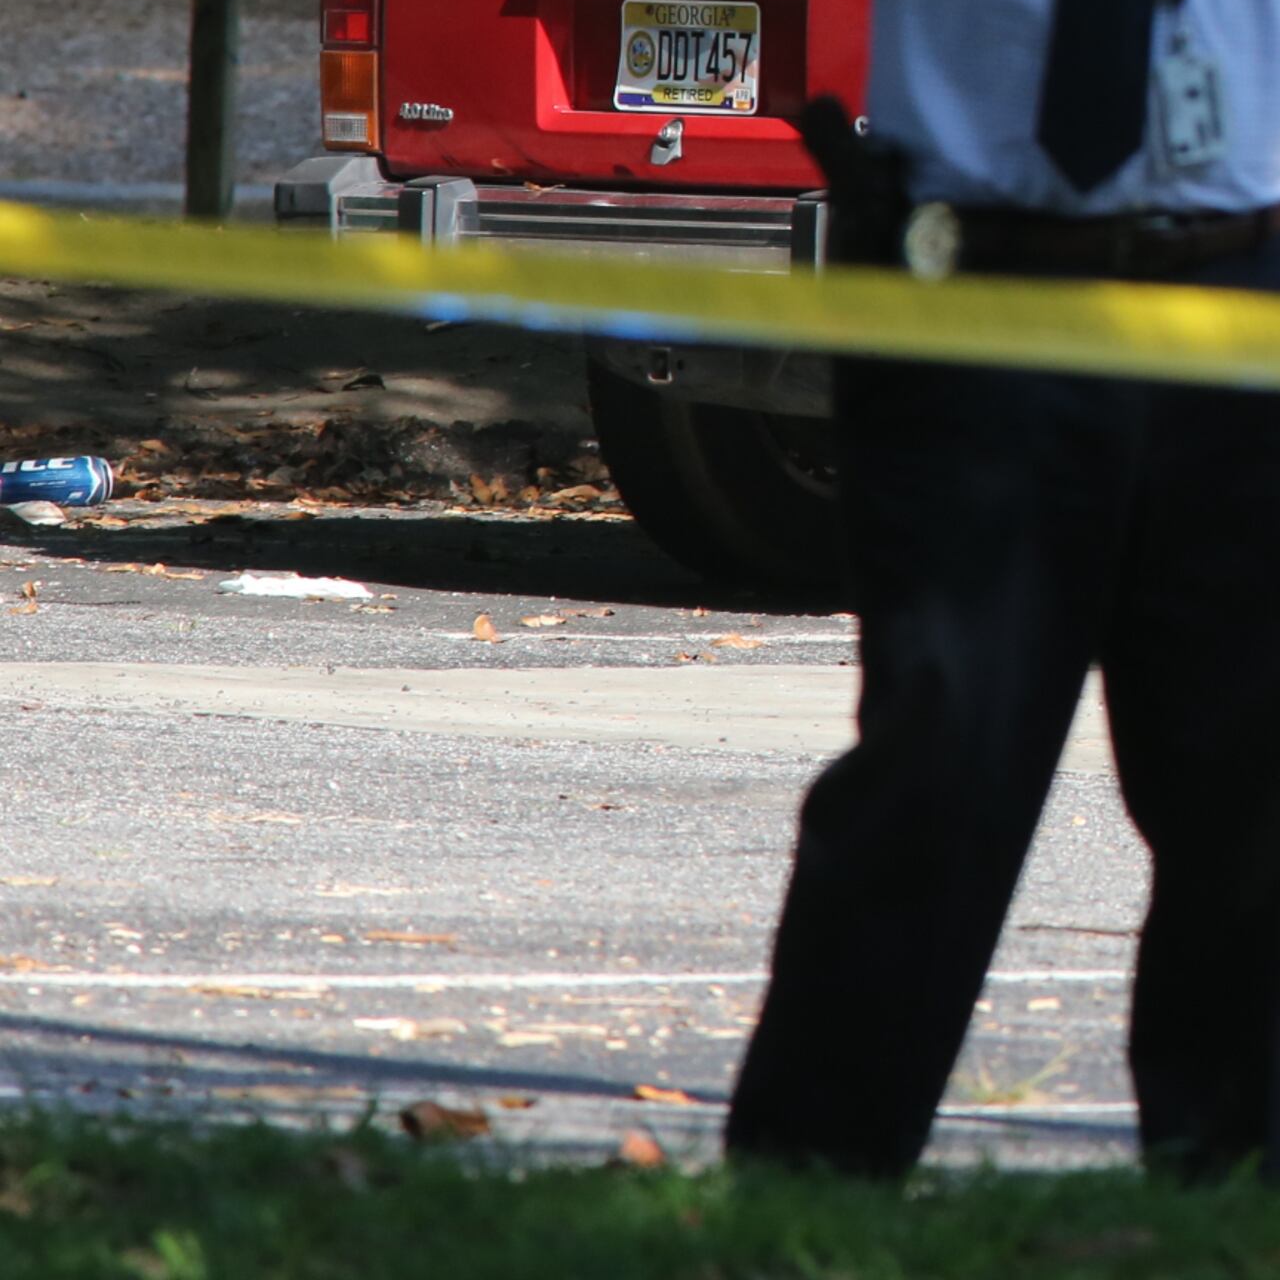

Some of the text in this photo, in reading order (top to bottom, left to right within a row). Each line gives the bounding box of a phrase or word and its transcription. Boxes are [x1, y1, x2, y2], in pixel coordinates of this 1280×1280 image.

[654, 4, 731, 26] GEORGIA
[657, 30, 754, 83] DDT457
[663, 87, 714, 102] RETIRED
